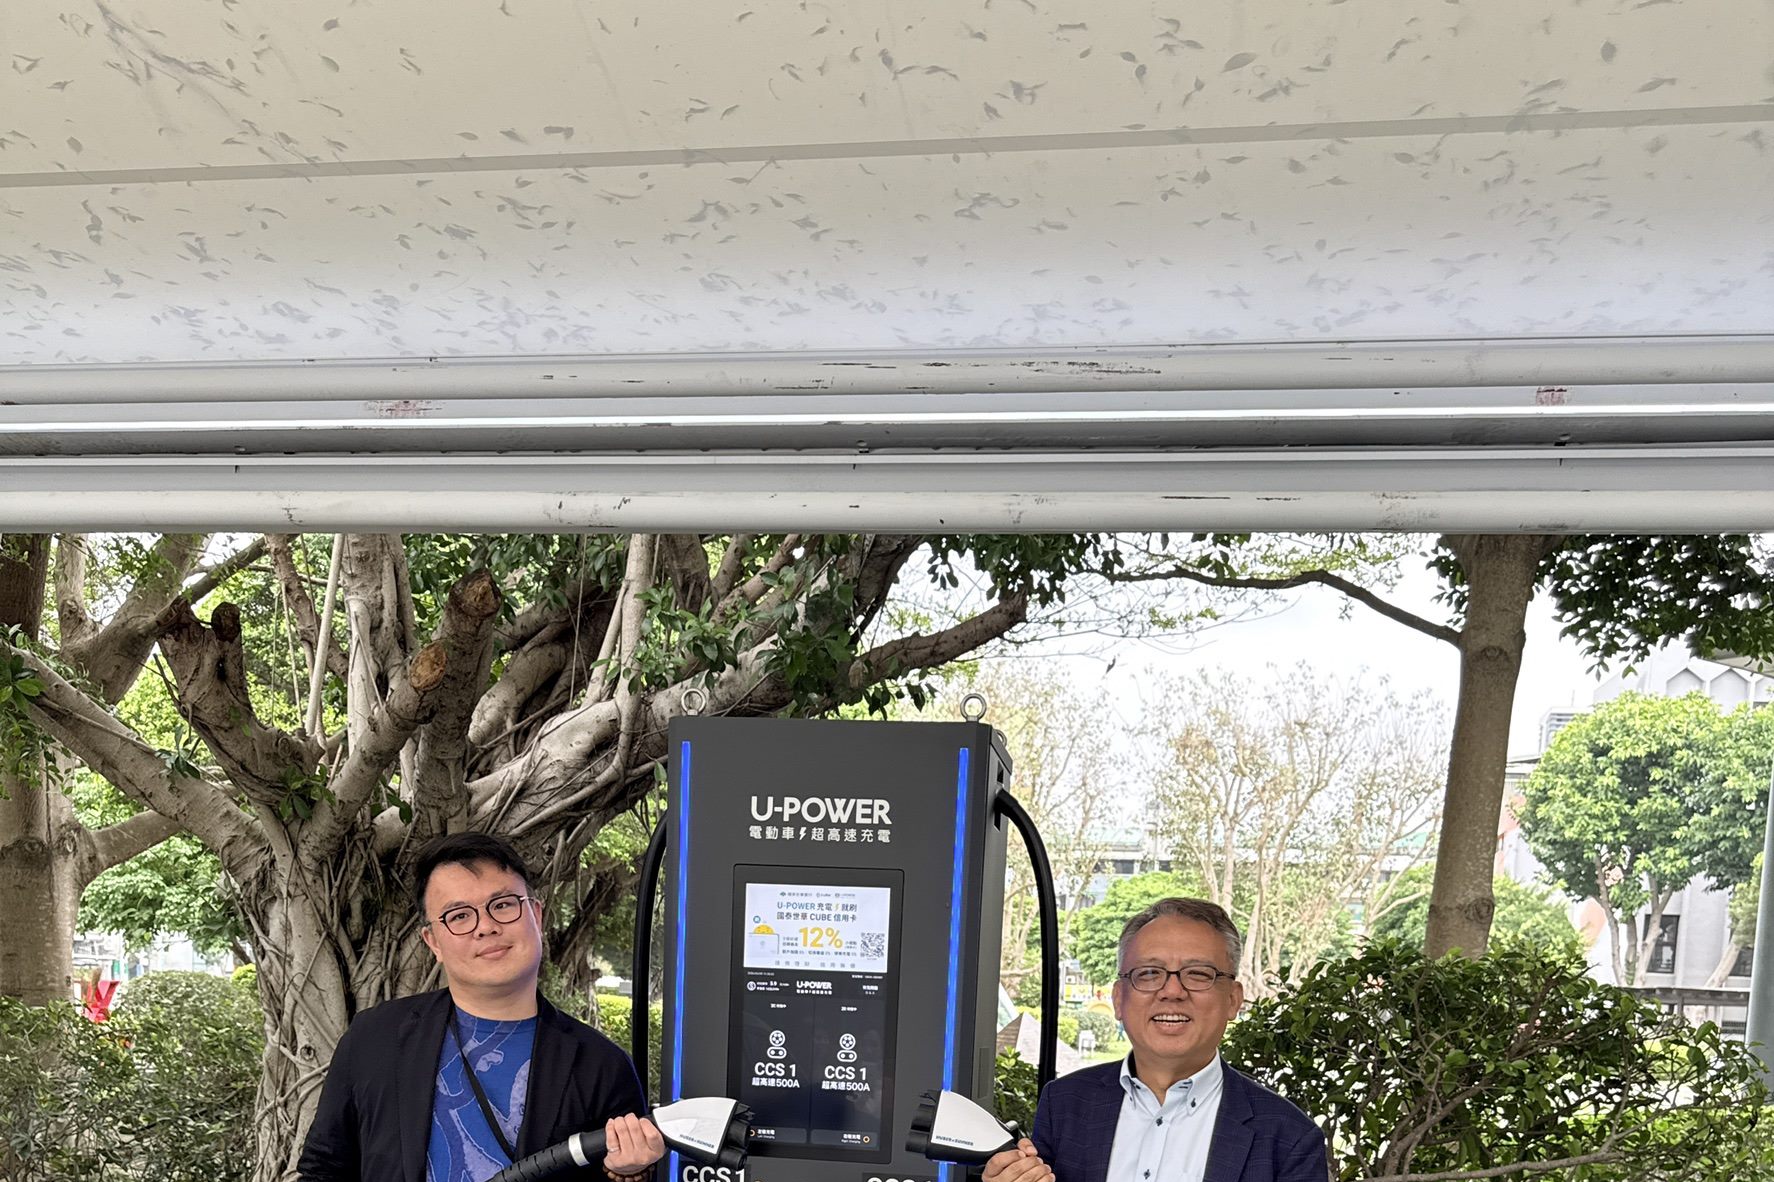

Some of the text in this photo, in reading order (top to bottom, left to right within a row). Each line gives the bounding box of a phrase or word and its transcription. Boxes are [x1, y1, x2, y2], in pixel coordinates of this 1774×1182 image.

[751, 796, 892, 824] U-POWER
[749, 825, 891, 843] 電動車 超高速充電
[777, 902, 815, 910] U-POWER
[810, 913, 832, 921] CUBE
[799, 927, 843, 949] 12%
[796, 980, 832, 989] U-POWER
[754, 1062, 796, 1077] CCS 1
[824, 1065, 867, 1080] CCS 1
